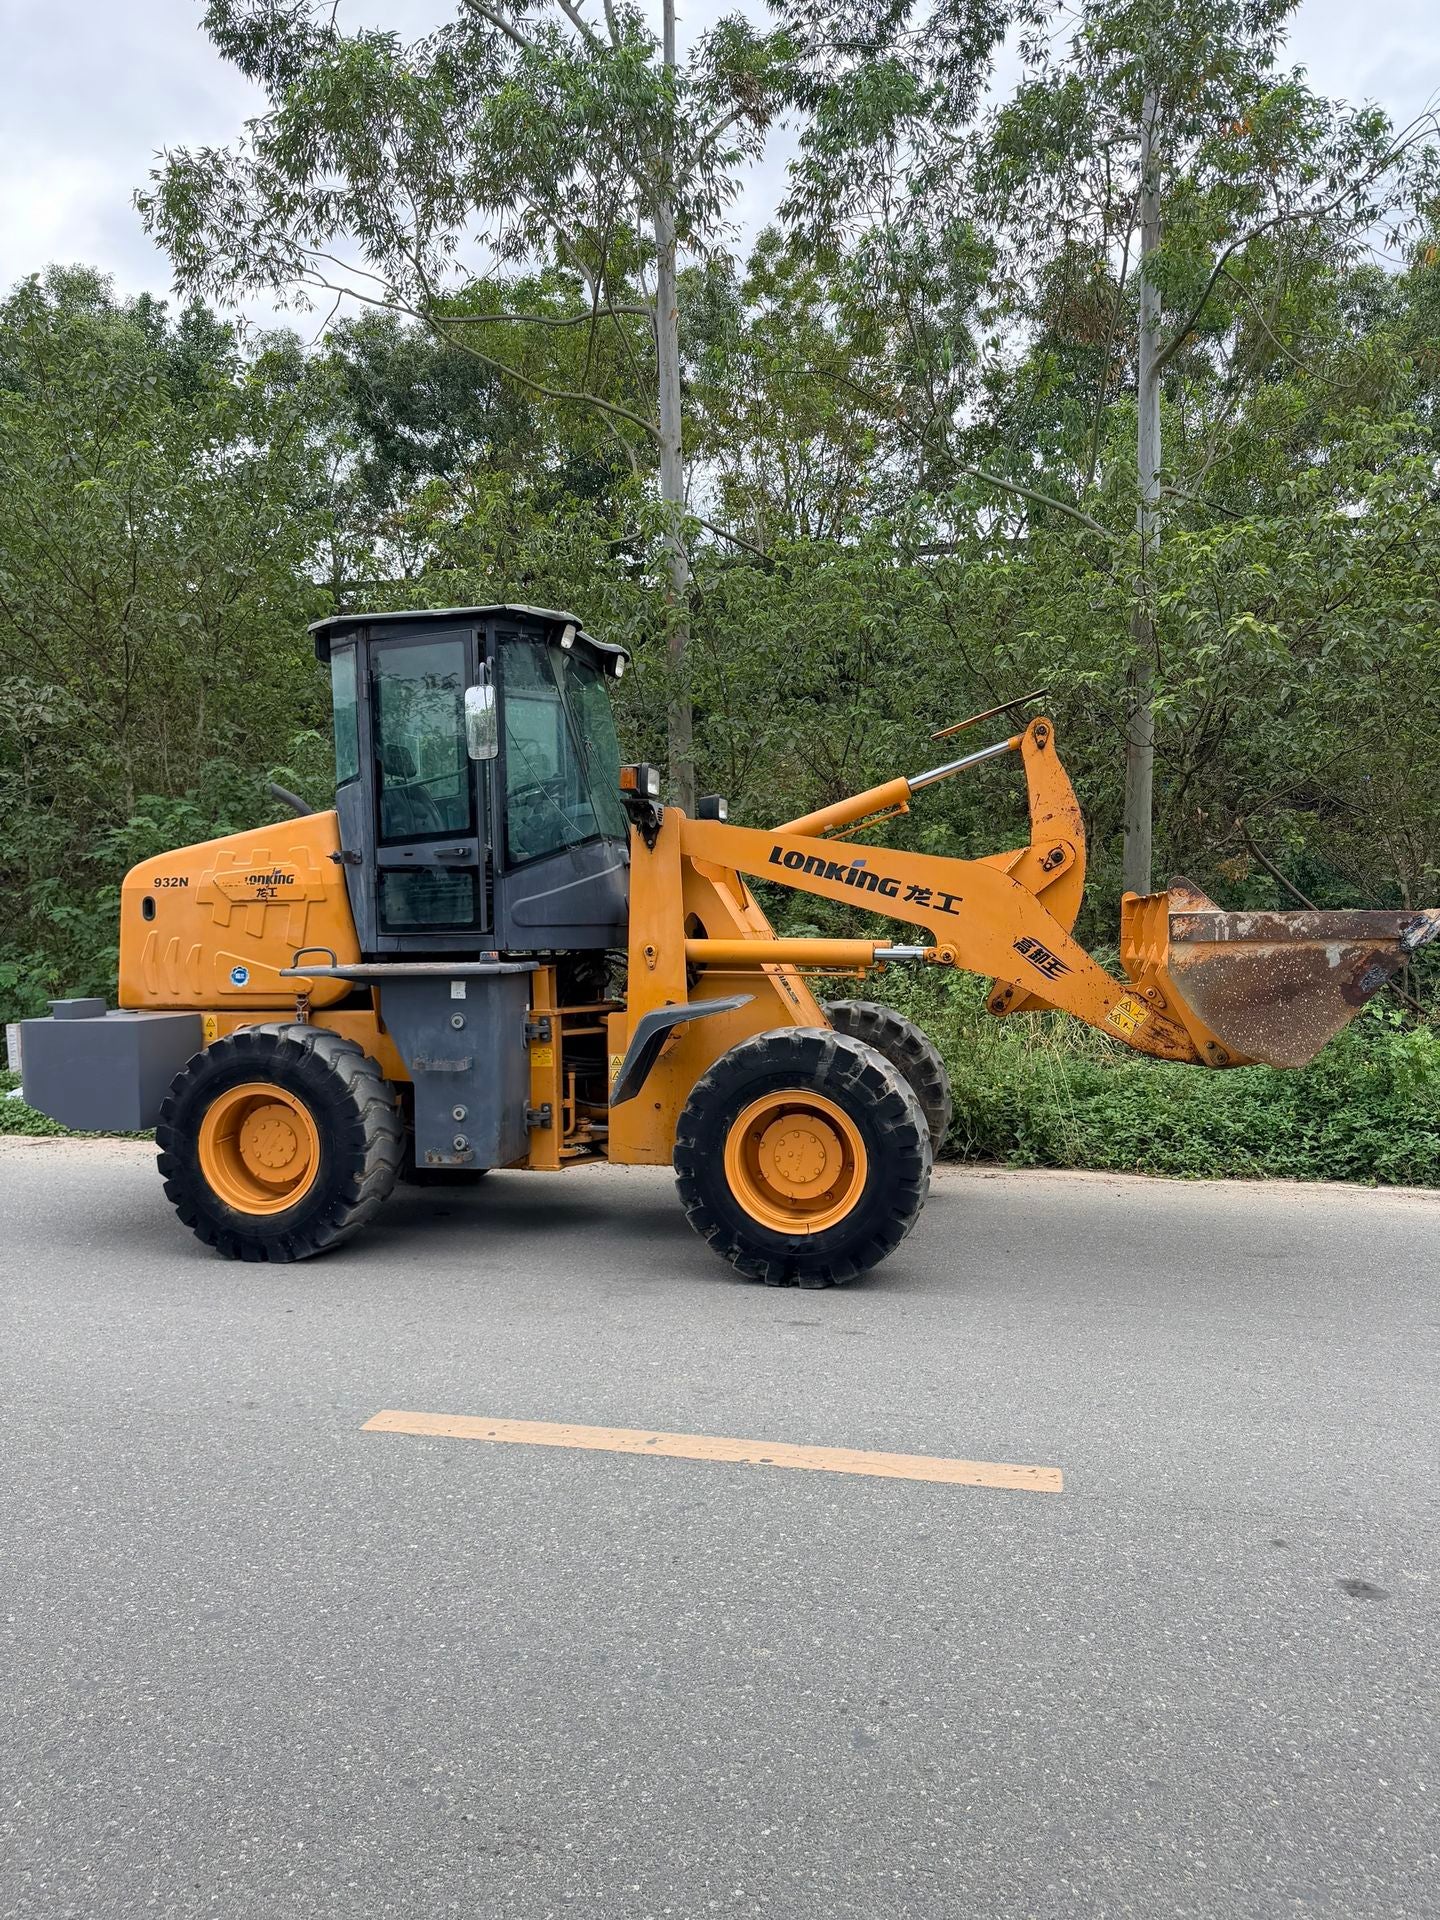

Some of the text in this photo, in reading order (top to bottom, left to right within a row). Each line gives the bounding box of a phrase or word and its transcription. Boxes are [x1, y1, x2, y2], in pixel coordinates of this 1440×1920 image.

[154, 877, 189, 887] 932N
[768, 846, 963, 915] LONKING 龙工
